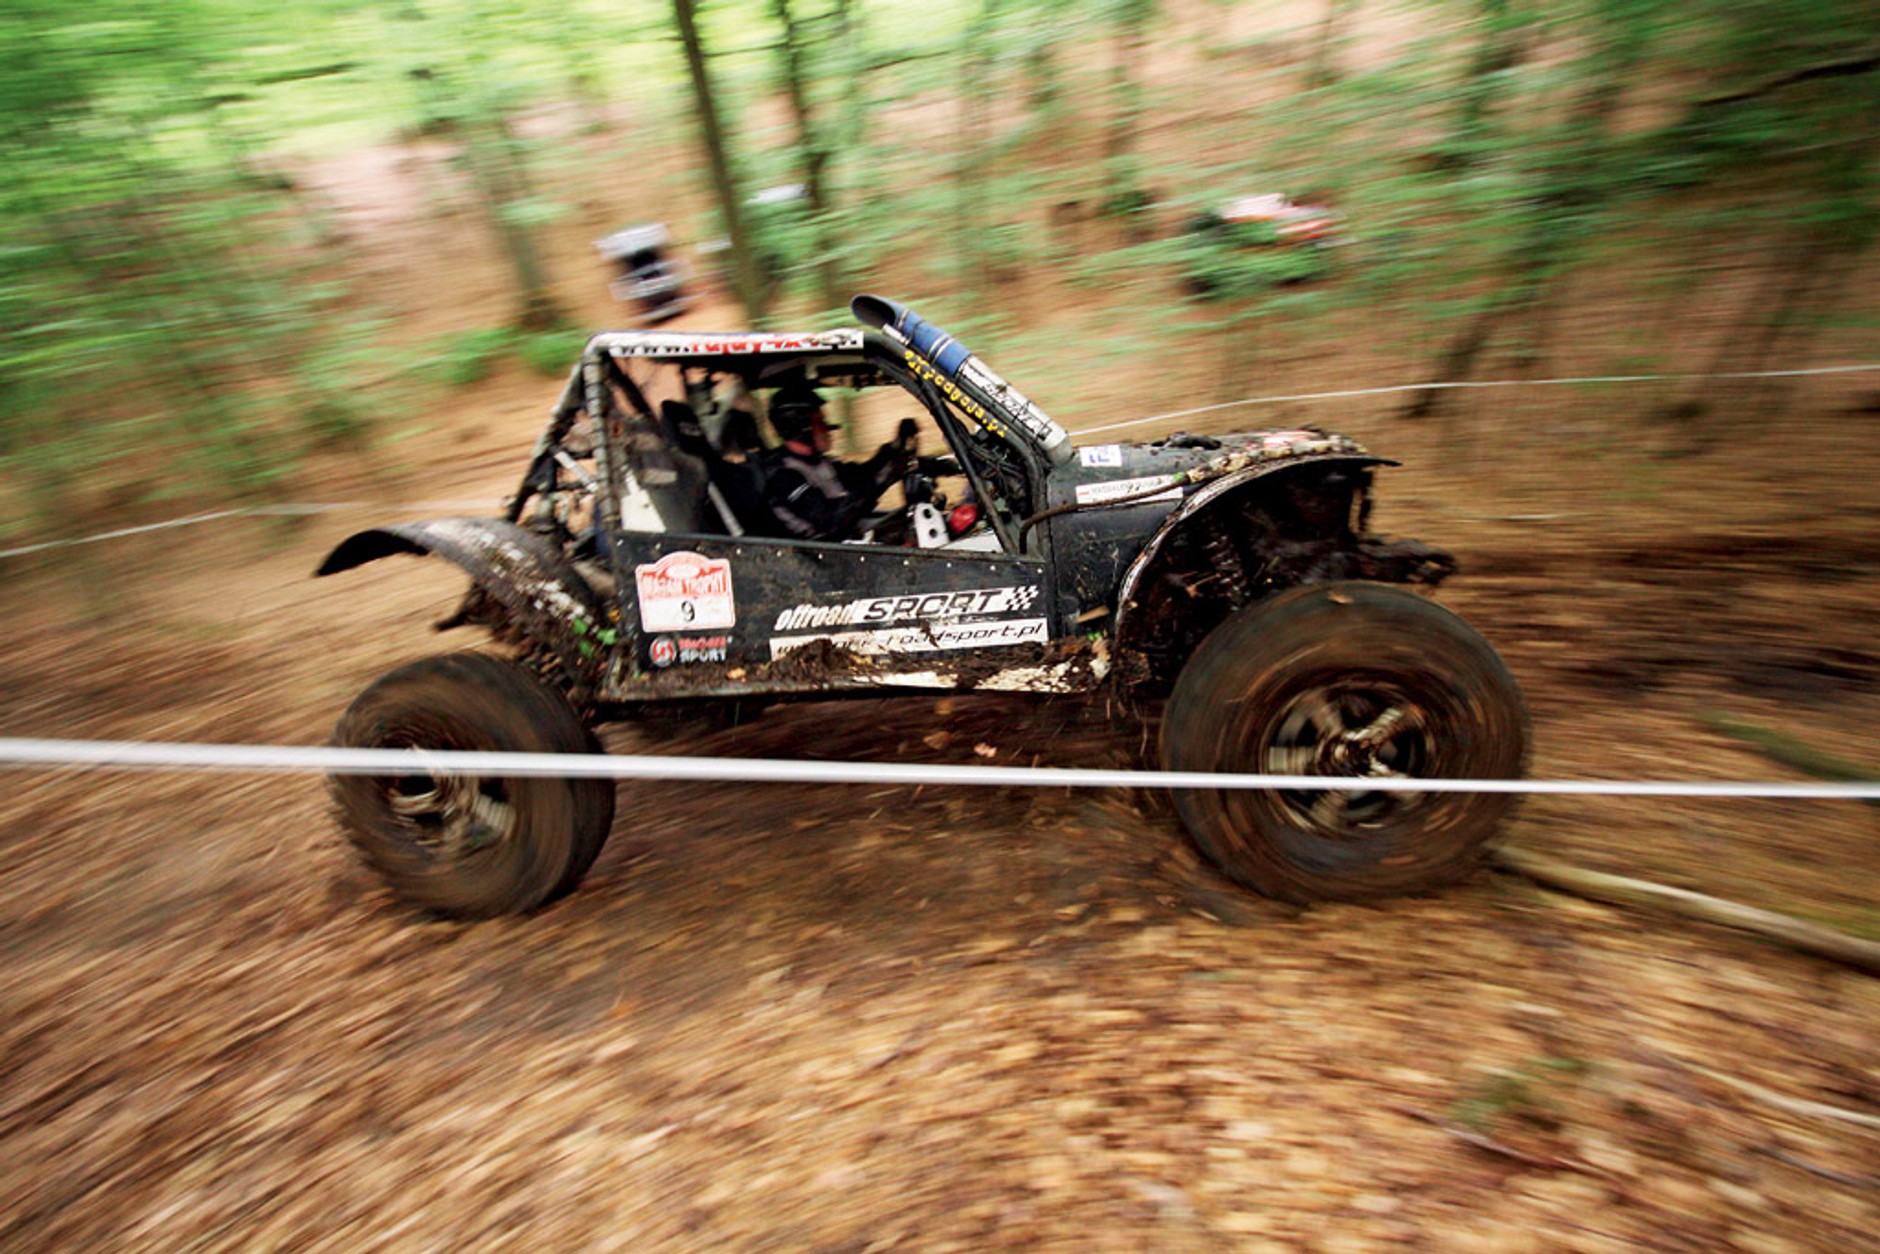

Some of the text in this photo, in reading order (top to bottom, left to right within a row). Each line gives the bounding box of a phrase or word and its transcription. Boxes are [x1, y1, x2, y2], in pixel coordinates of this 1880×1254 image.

[681, 601, 696, 622] 9
[774, 589, 1003, 631] offroad SPORT
[679, 648, 727, 664] SPORT
